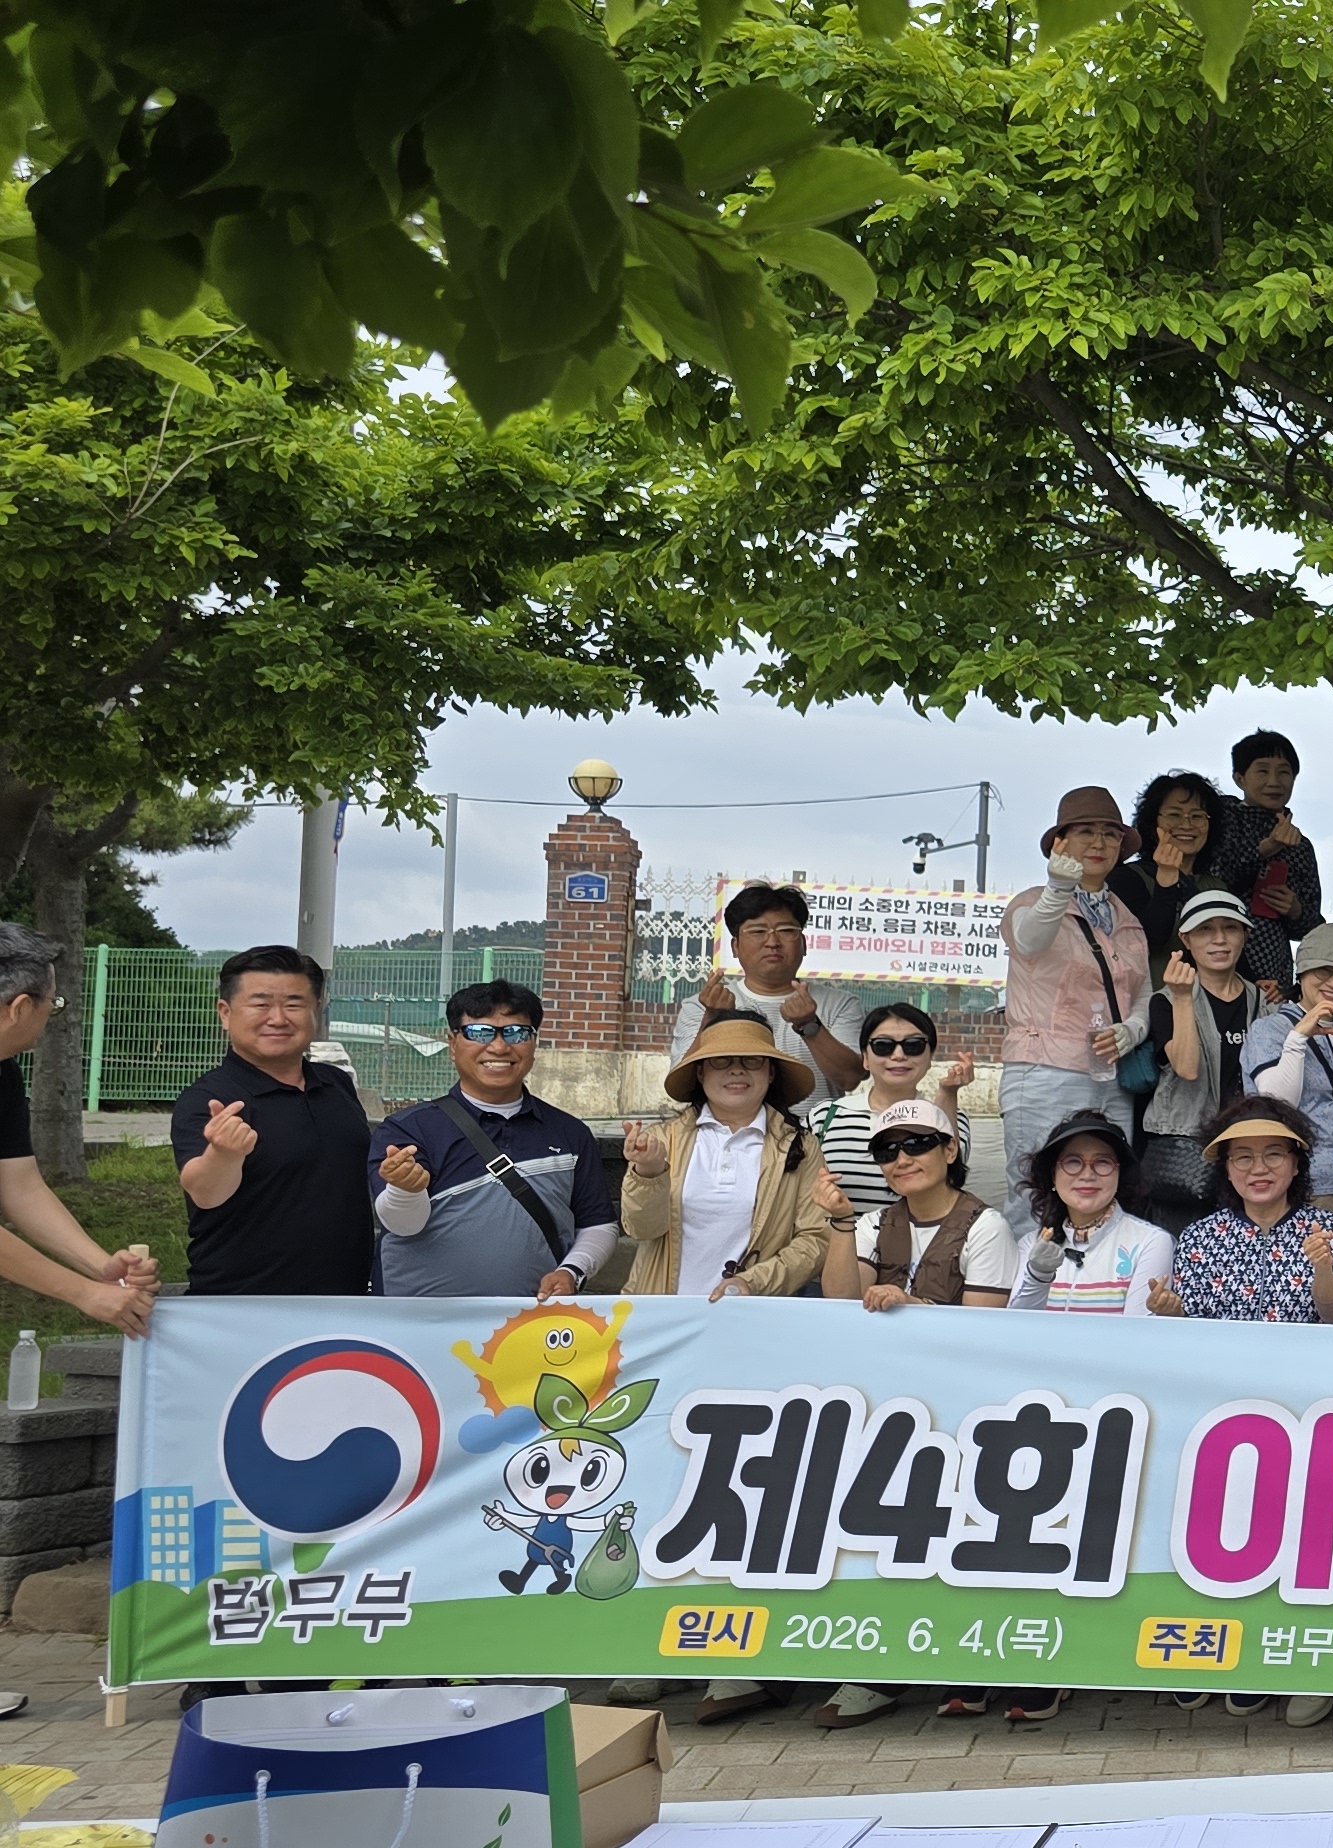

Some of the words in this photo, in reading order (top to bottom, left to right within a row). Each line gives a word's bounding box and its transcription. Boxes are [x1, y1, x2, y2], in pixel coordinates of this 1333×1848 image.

[571, 886, 600, 899] 61
[858, 898, 911, 914] 소중한
[915, 899, 967, 918] 자연을
[837, 916, 877, 934] 차량,
[883, 917, 917, 935] 응급
[922, 920, 962, 938] 차량,
[838, 936, 924, 956] 금지하오니
[930, 940, 998, 959] 협조하여
[906, 960, 984, 975] 시설관리사업소
[655, 1397, 1134, 1583] 제4회
[213, 1571, 411, 1641] 법무부
[678, 1609, 754, 1650] 일시
[779, 1614, 888, 1655] 2026.
[906, 1617, 941, 1656] 6.
[957, 1615, 1064, 1662] 4.(목)
[1148, 1624, 1228, 1663] 주최
